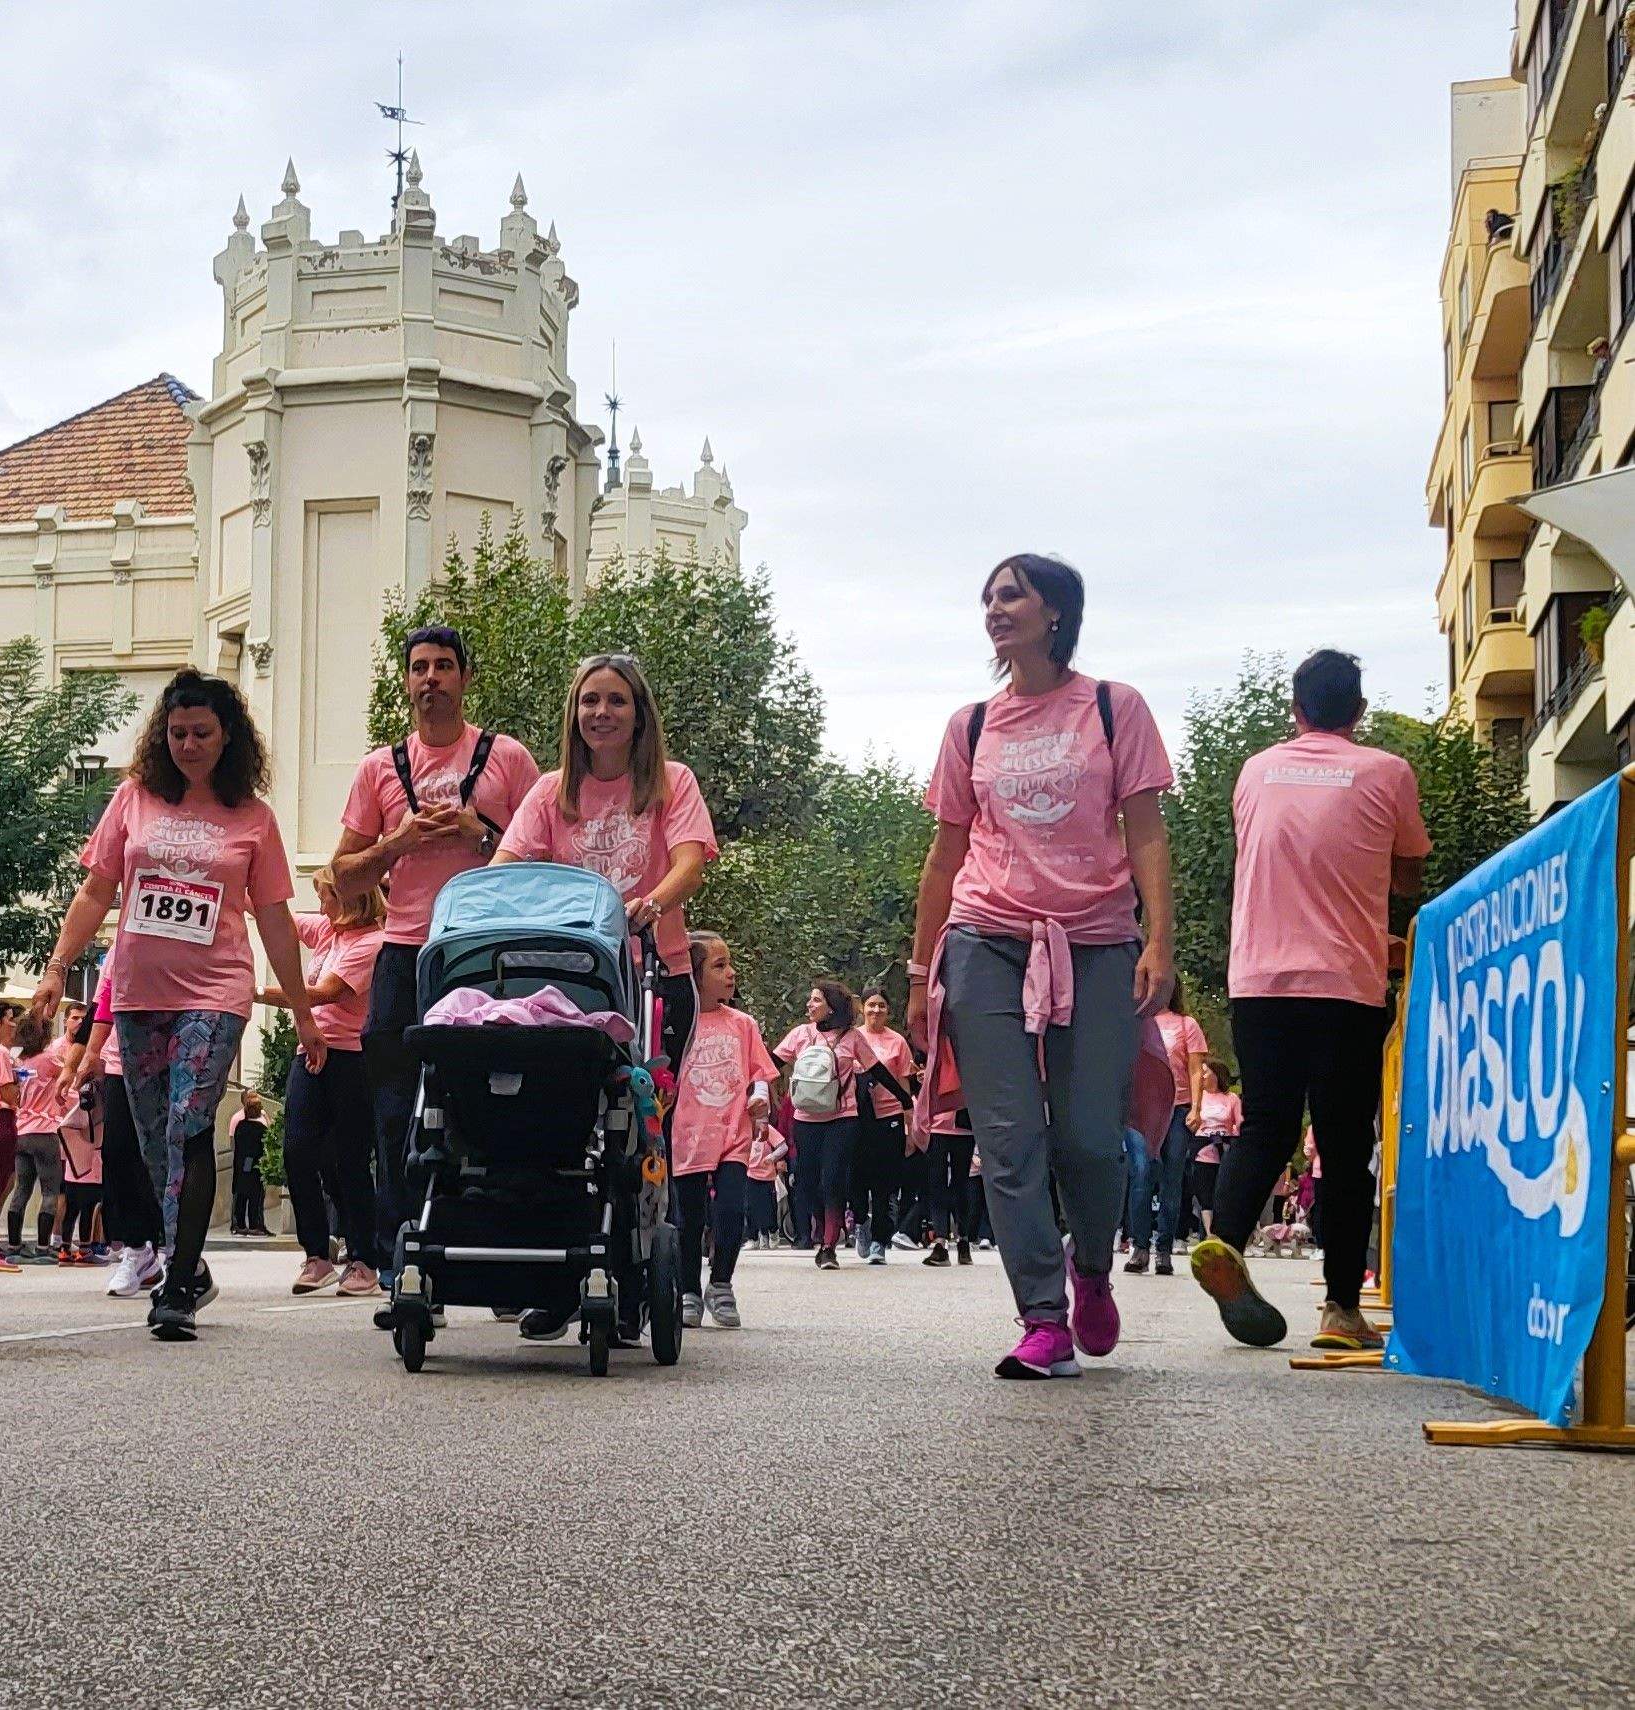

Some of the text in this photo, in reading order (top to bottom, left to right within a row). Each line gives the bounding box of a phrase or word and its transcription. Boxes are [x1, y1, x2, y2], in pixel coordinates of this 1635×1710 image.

[144, 883, 173, 893] CONTRA
[141, 894, 210, 927] 1891
[1425, 924, 1567, 1160] blasco
